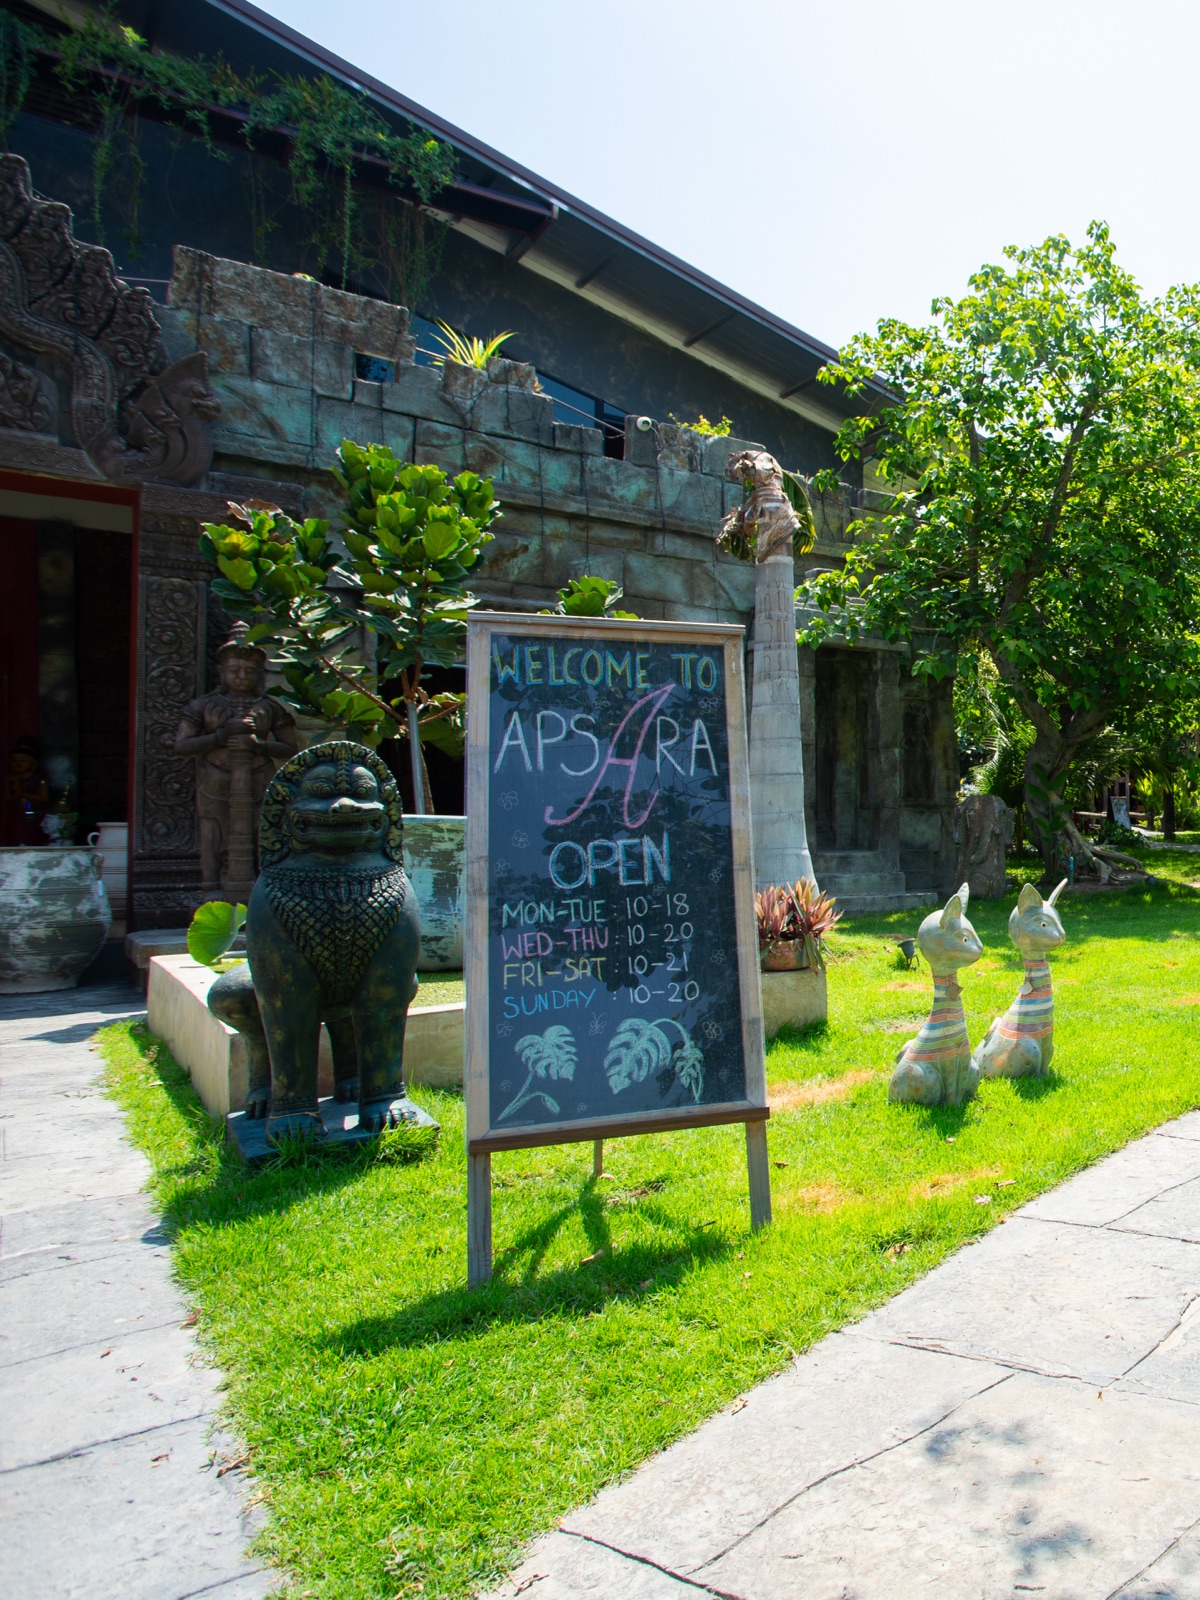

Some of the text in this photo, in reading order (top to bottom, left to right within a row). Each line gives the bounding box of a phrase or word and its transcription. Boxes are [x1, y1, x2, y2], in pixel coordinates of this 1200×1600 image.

[492, 643, 717, 692] WELCOME TO
[494, 683, 719, 828] APSARA
[549, 831, 672, 889] OPEN
[502, 899, 608, 928] MON-TUE
[501, 926, 609, 961] WED-THU
[503, 957, 607, 990] FRI-SAT
[503, 988, 597, 1019] SUNDAY
